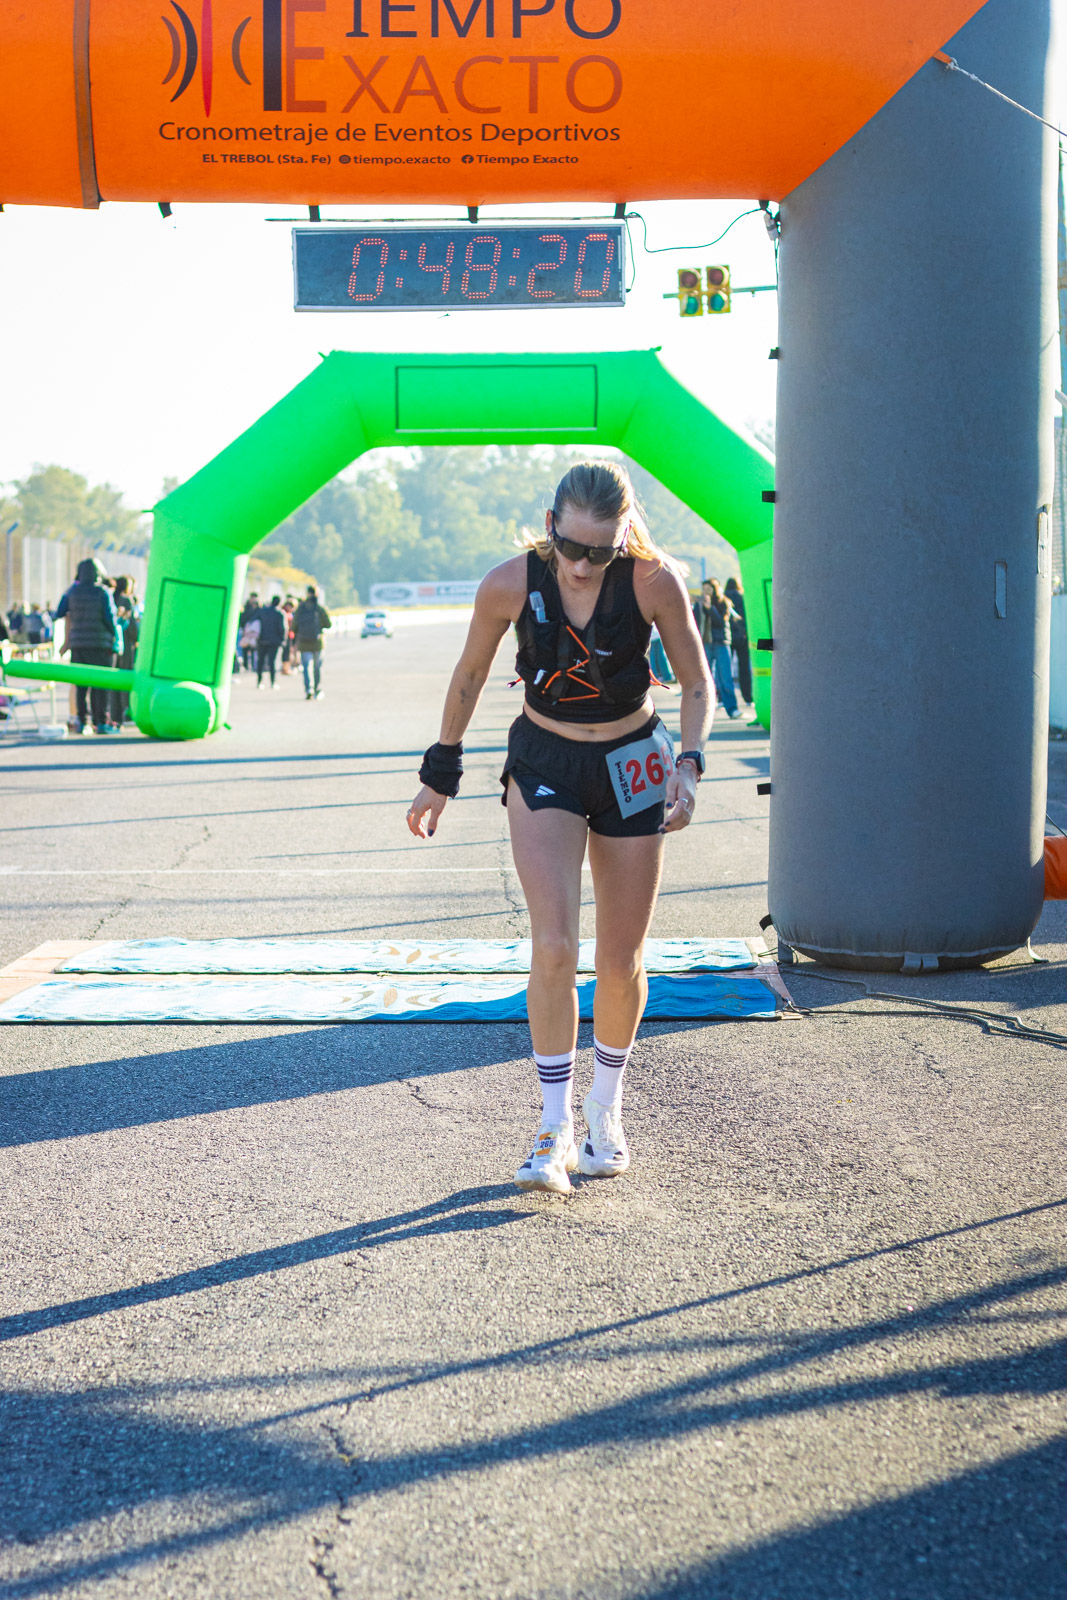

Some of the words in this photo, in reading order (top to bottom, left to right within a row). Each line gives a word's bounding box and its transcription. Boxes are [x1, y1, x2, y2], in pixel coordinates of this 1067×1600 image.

[158, 121, 328, 146] Cronometraje
[335, 122, 366, 141] de
[374, 123, 473, 142] Eventos
[481, 123, 620, 146] Deportivos
[202, 153, 218, 163] EL
[220, 153, 274, 164] TREBOL
[277, 154, 308, 165] (Sta.
[311, 154, 332, 165] Fe)
[353, 154, 451, 166] tiempo.exacto
[476, 154, 529, 166] Tiempo
[533, 154, 579, 165] Exacto
[348, 234, 614, 300] 0:48:20
